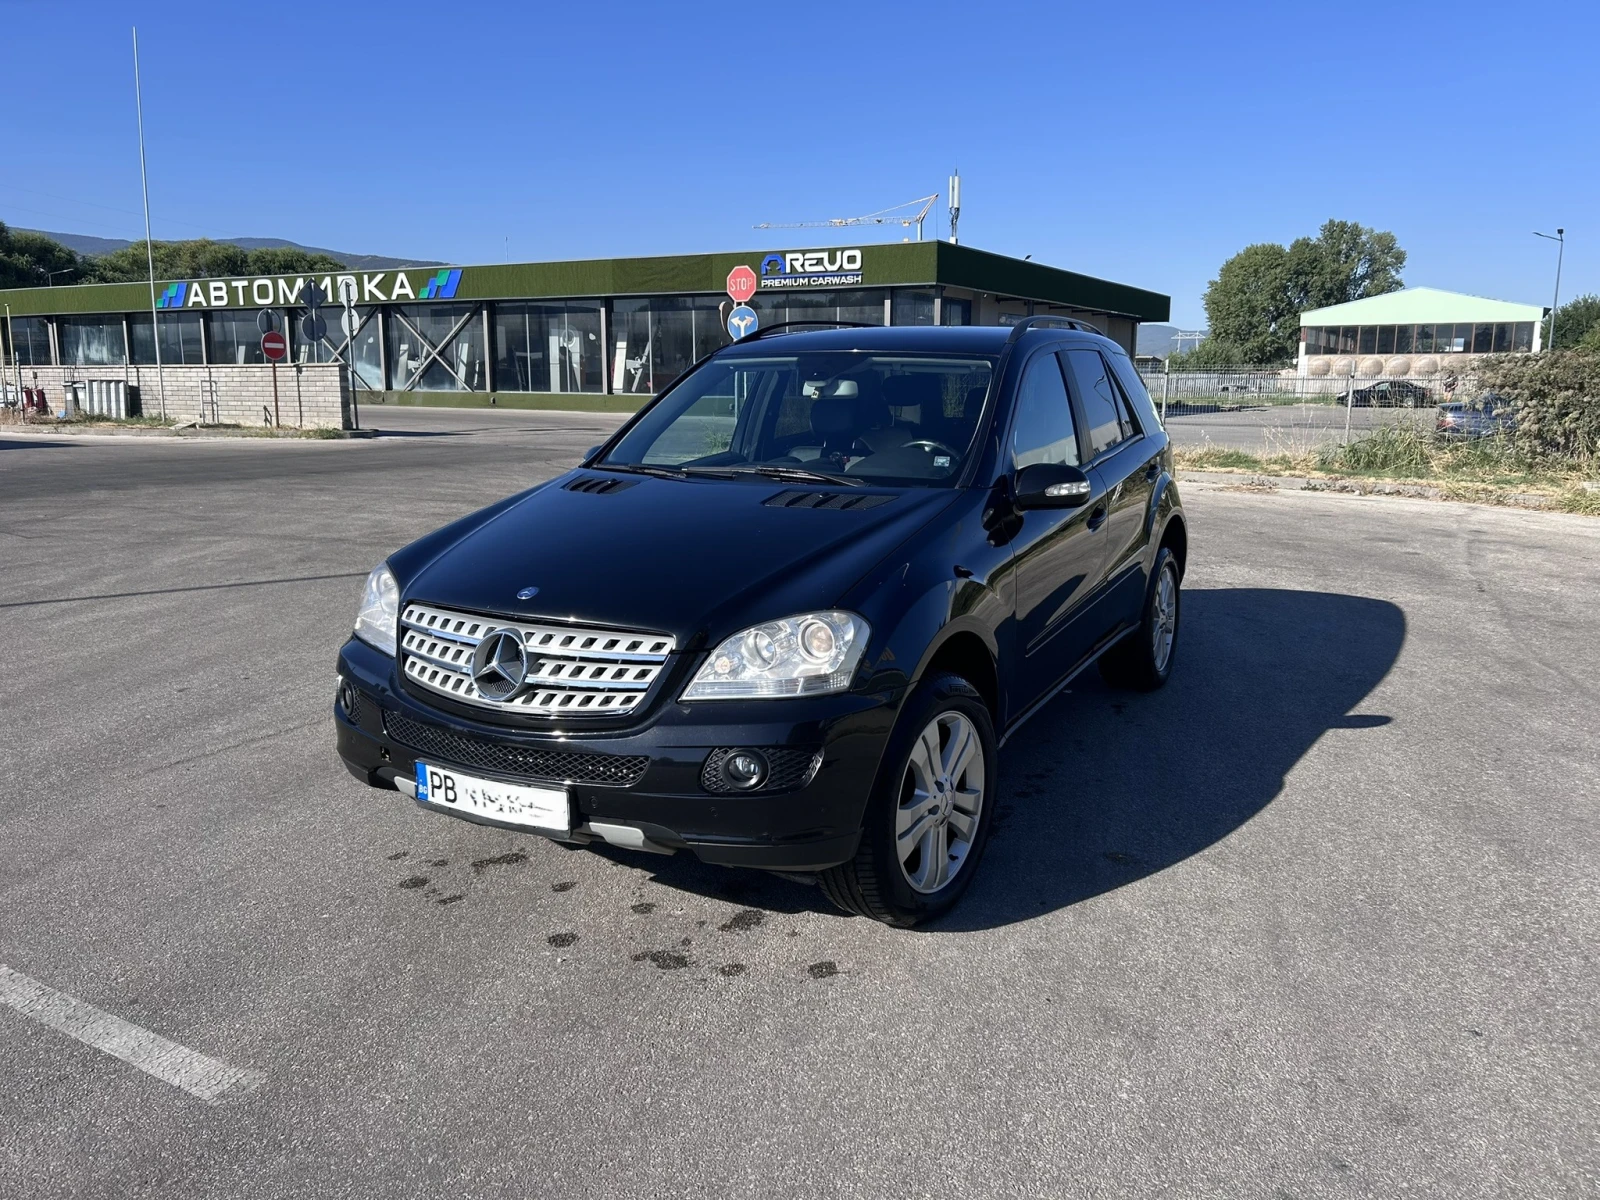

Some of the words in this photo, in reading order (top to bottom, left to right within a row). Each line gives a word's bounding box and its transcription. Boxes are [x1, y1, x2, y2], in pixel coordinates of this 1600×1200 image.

[730, 277, 752, 292] STOP
[761, 277, 809, 288] PREMIUM
[810, 275, 862, 286] CARWASH
[418, 784, 428, 795] BG
